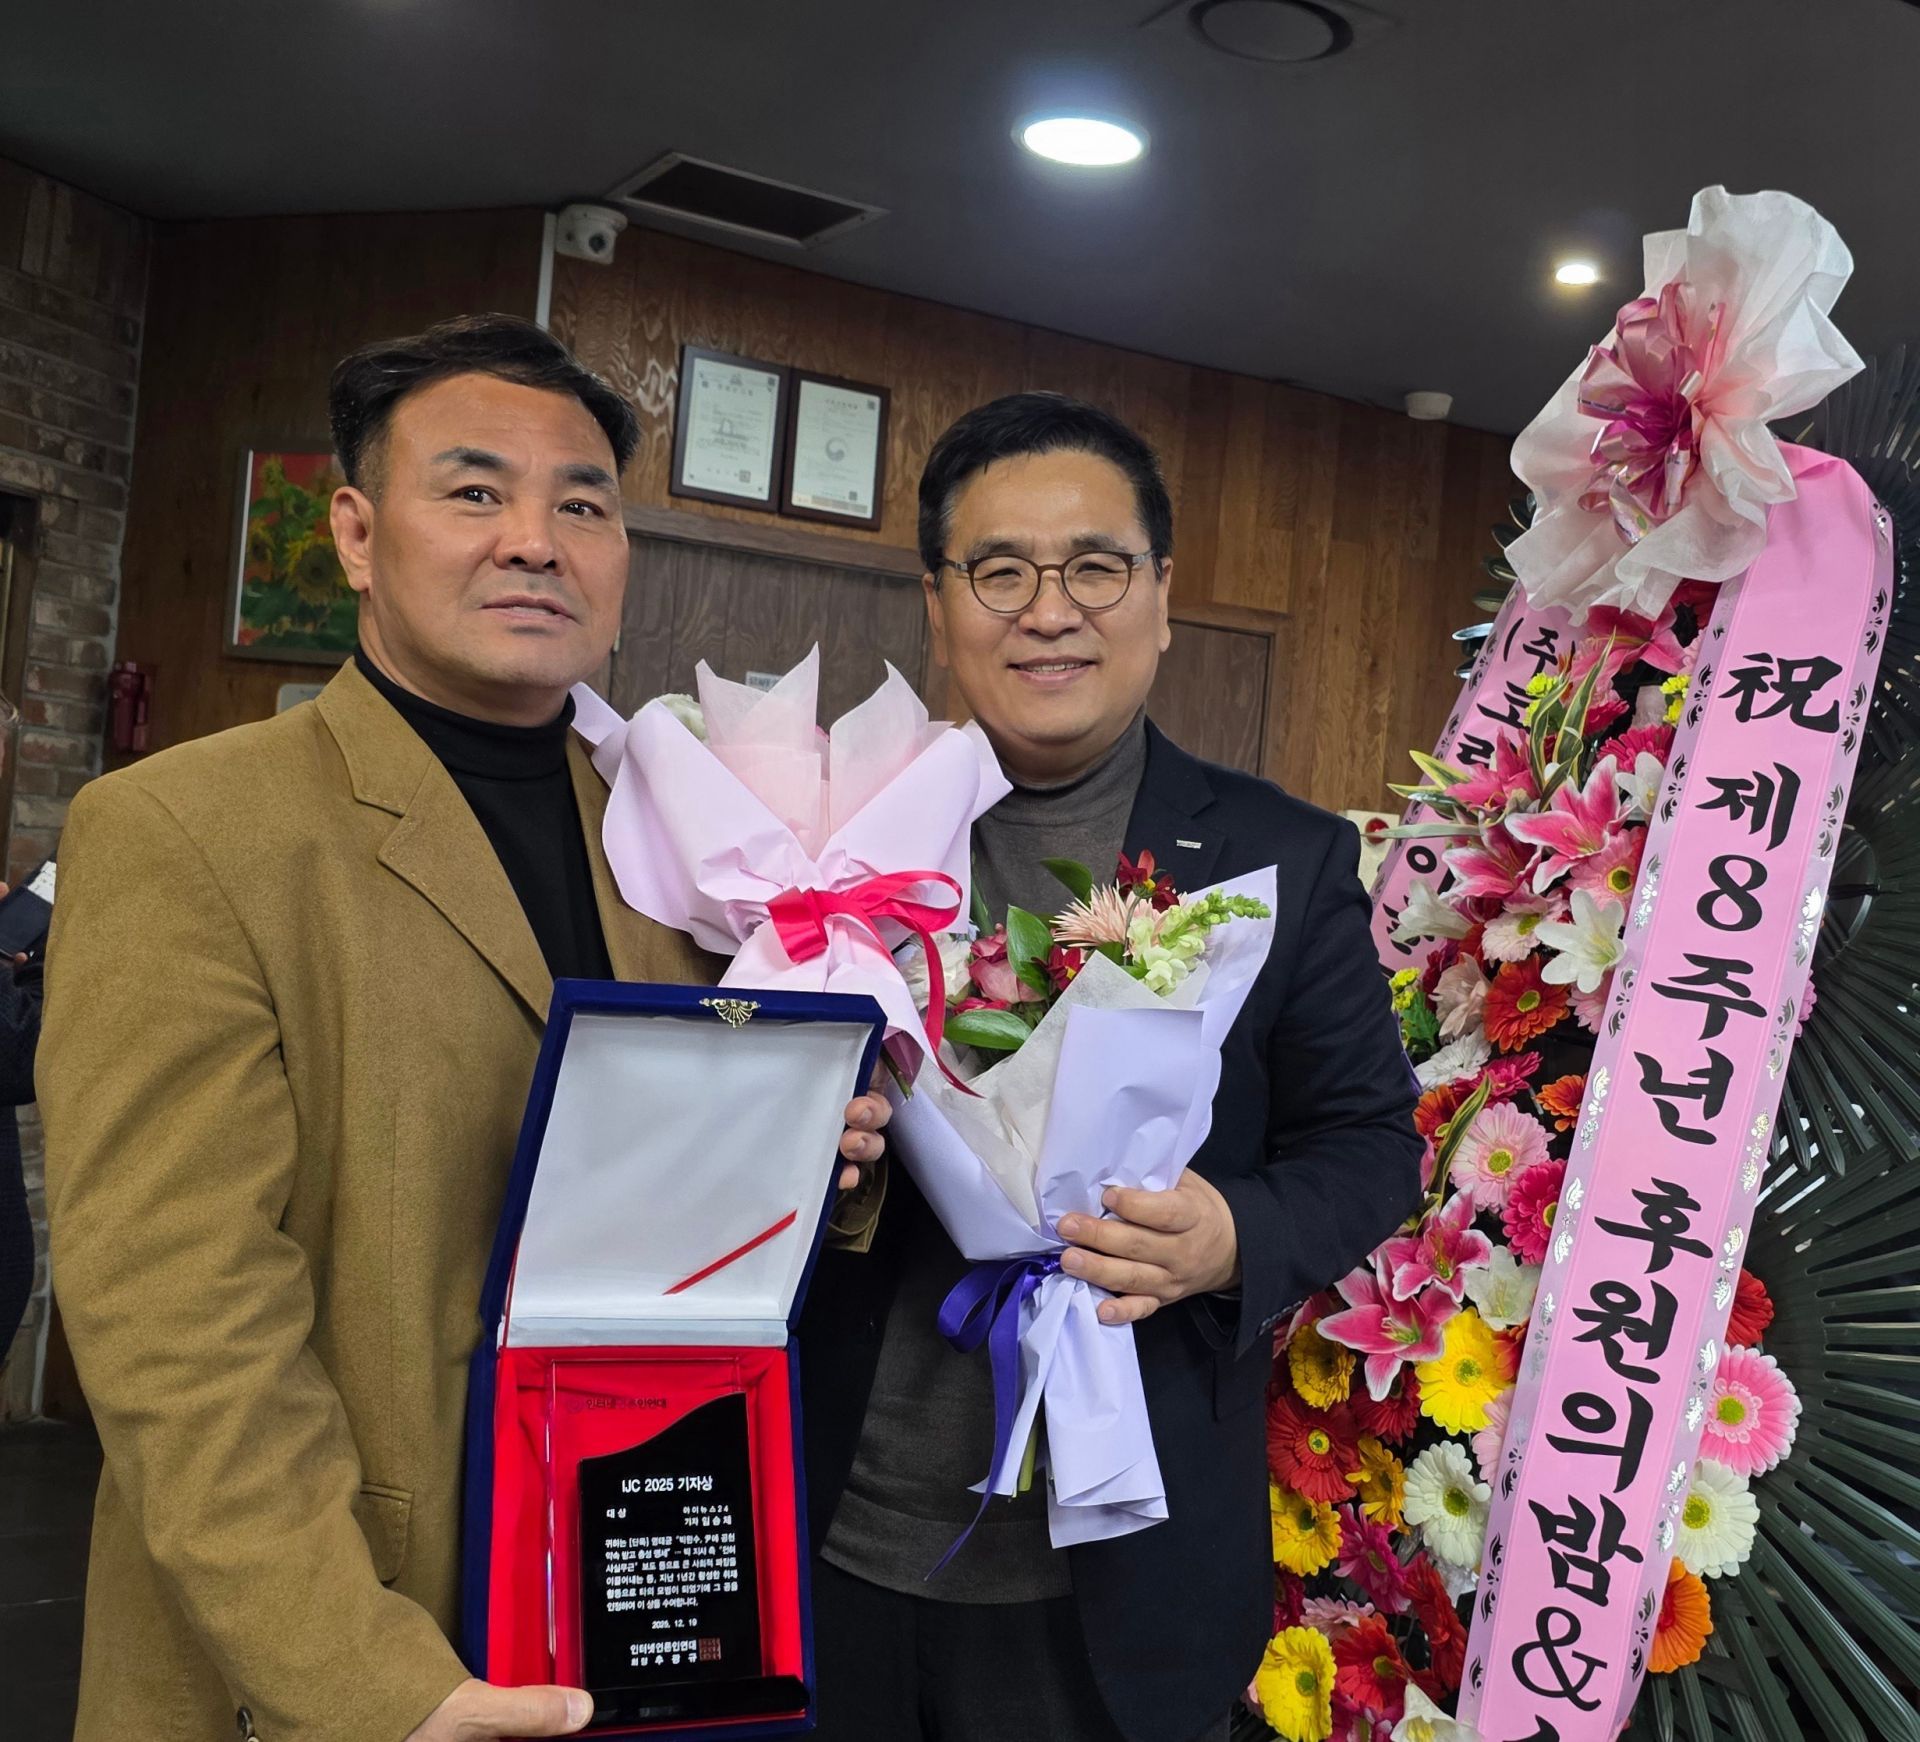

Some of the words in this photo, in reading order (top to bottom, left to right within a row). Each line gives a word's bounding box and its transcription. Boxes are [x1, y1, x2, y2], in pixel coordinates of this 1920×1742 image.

[1719, 652, 1843, 733] 祝
[1634, 762, 1801, 1145] 제8주년
[1546, 1177, 1712, 1492] 후원의
[645, 1478, 673, 1492] 2025
[678, 1476, 712, 1491] 기자상
[685, 1517, 698, 1526] 기자
[1529, 1493, 1643, 1607] 밤
[692, 1559, 713, 1568] 사회적
[660, 1573, 674, 1582] 지난
[713, 1583, 720, 1591] 그
[637, 1600, 644, 1609] 이
[630, 1640, 696, 1655] 인터넷언론인연대
[1512, 1606, 1607, 1711] &
